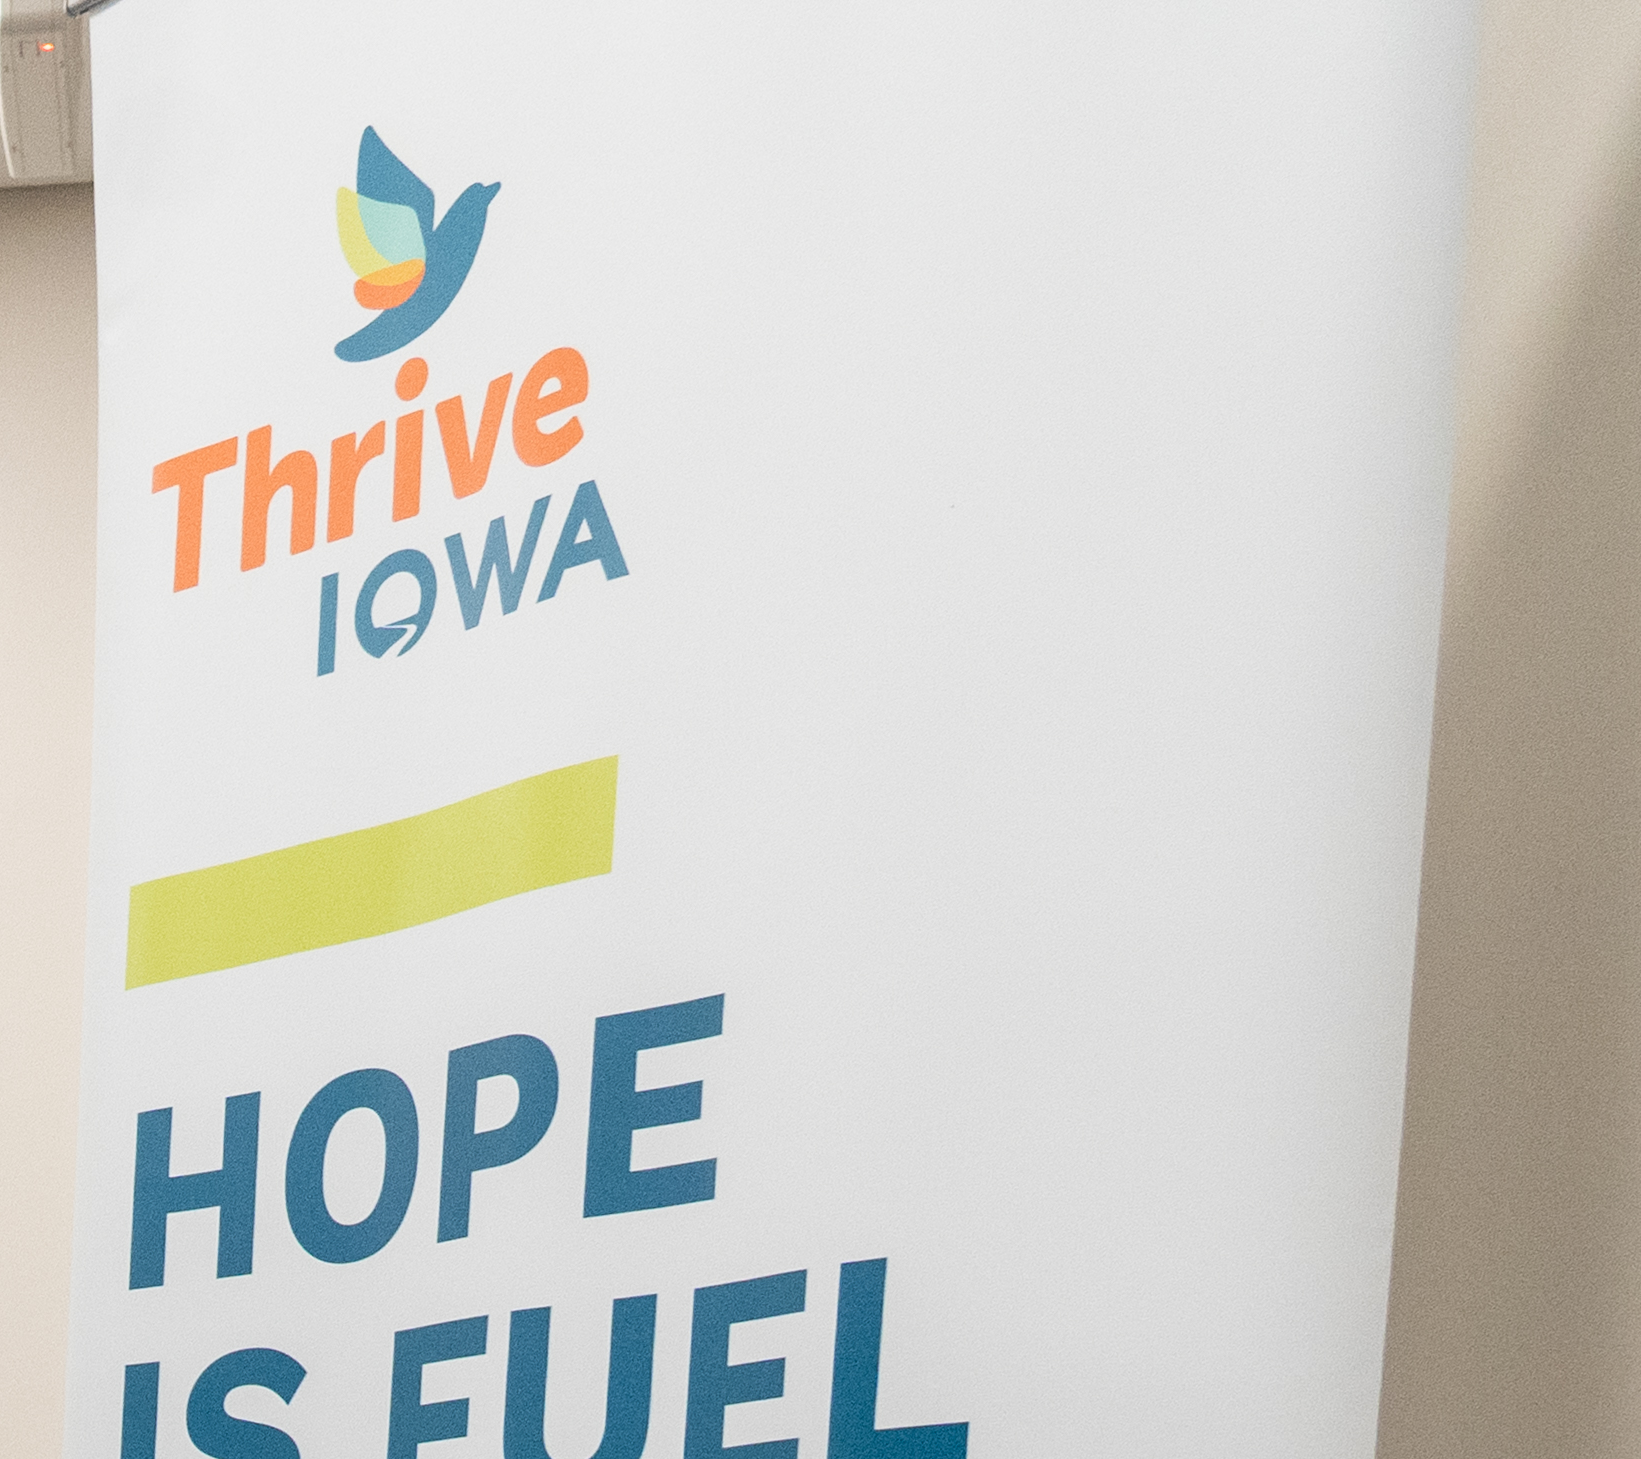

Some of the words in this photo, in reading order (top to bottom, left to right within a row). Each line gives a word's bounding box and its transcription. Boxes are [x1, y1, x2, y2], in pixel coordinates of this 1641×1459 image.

[151, 346, 589, 594] Thrive
[316, 480, 629, 677] IOWA
[128, 993, 726, 1291] HOPE
